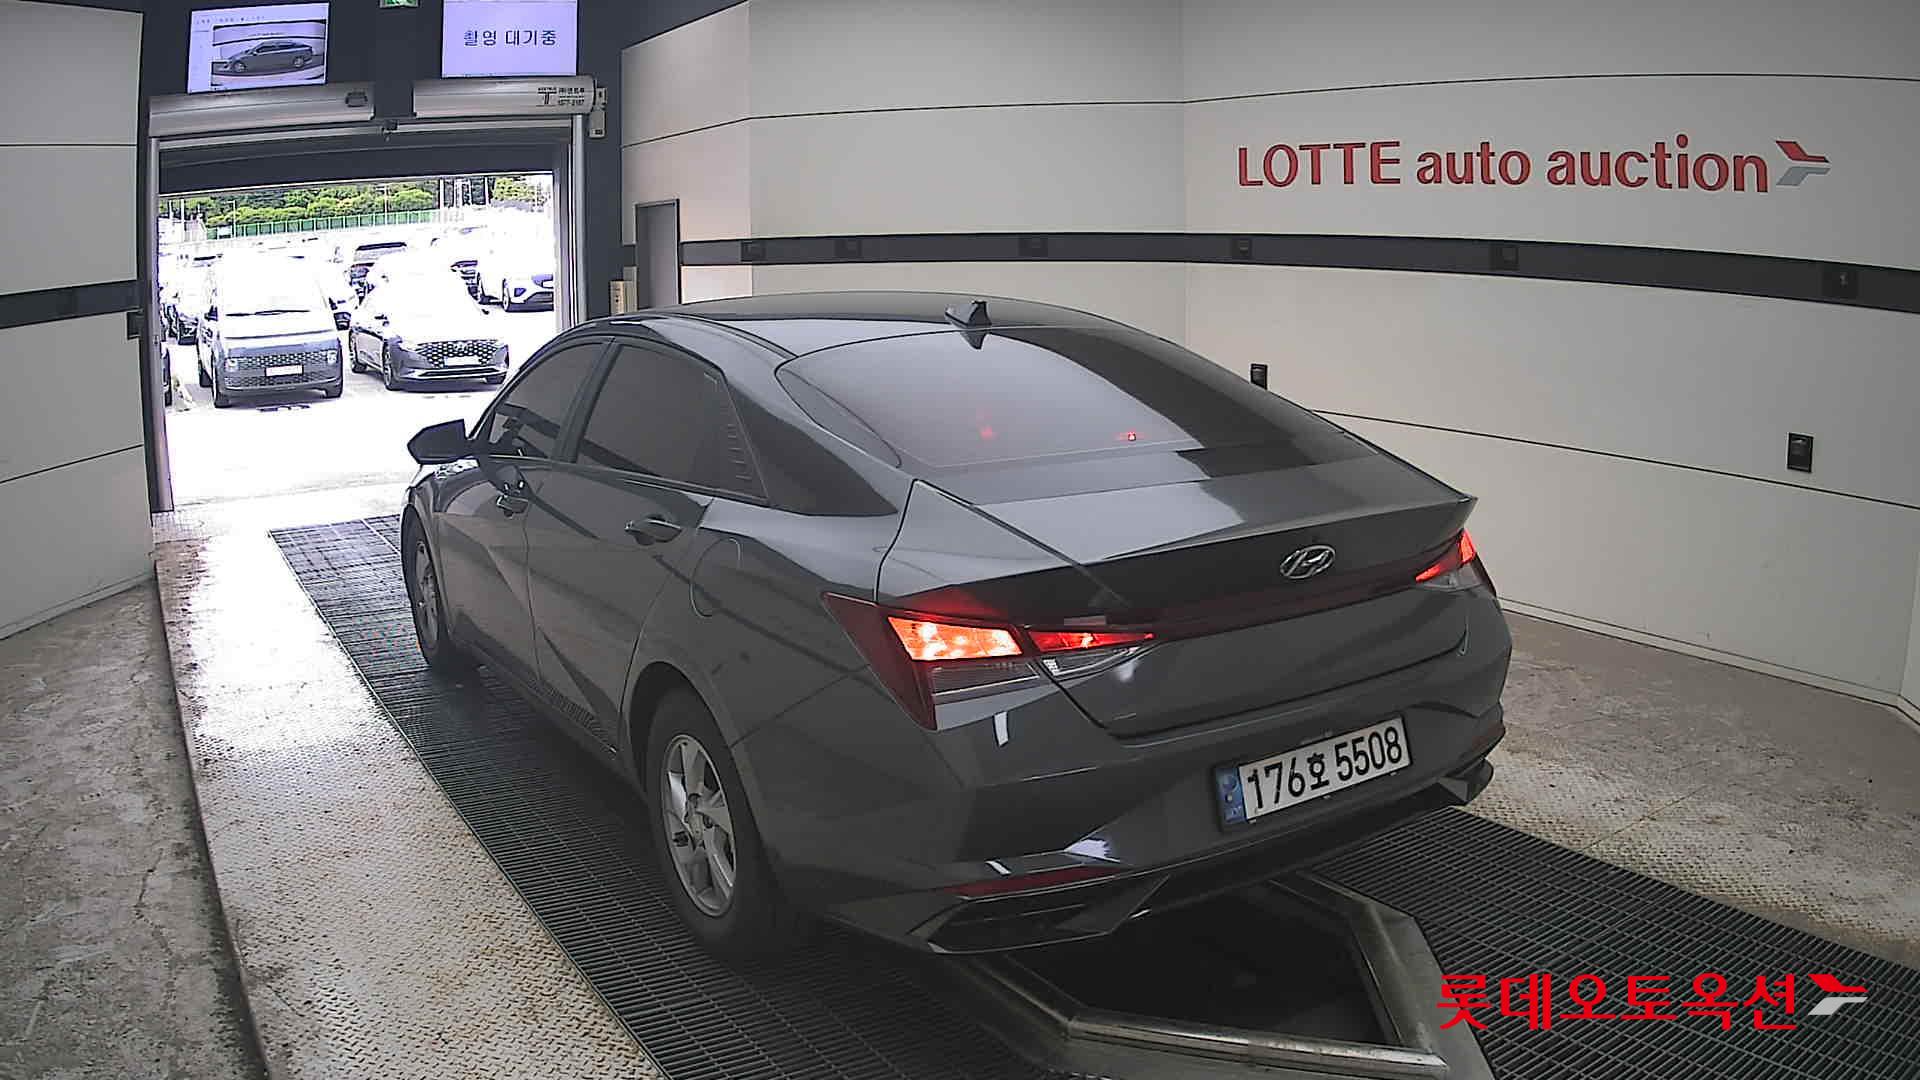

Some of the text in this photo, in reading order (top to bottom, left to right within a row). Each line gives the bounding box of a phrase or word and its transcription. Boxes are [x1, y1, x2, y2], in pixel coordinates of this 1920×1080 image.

[464, 29, 557, 47] 촬영 대기중
[1238, 134, 1768, 193] LOTTE auto auction
